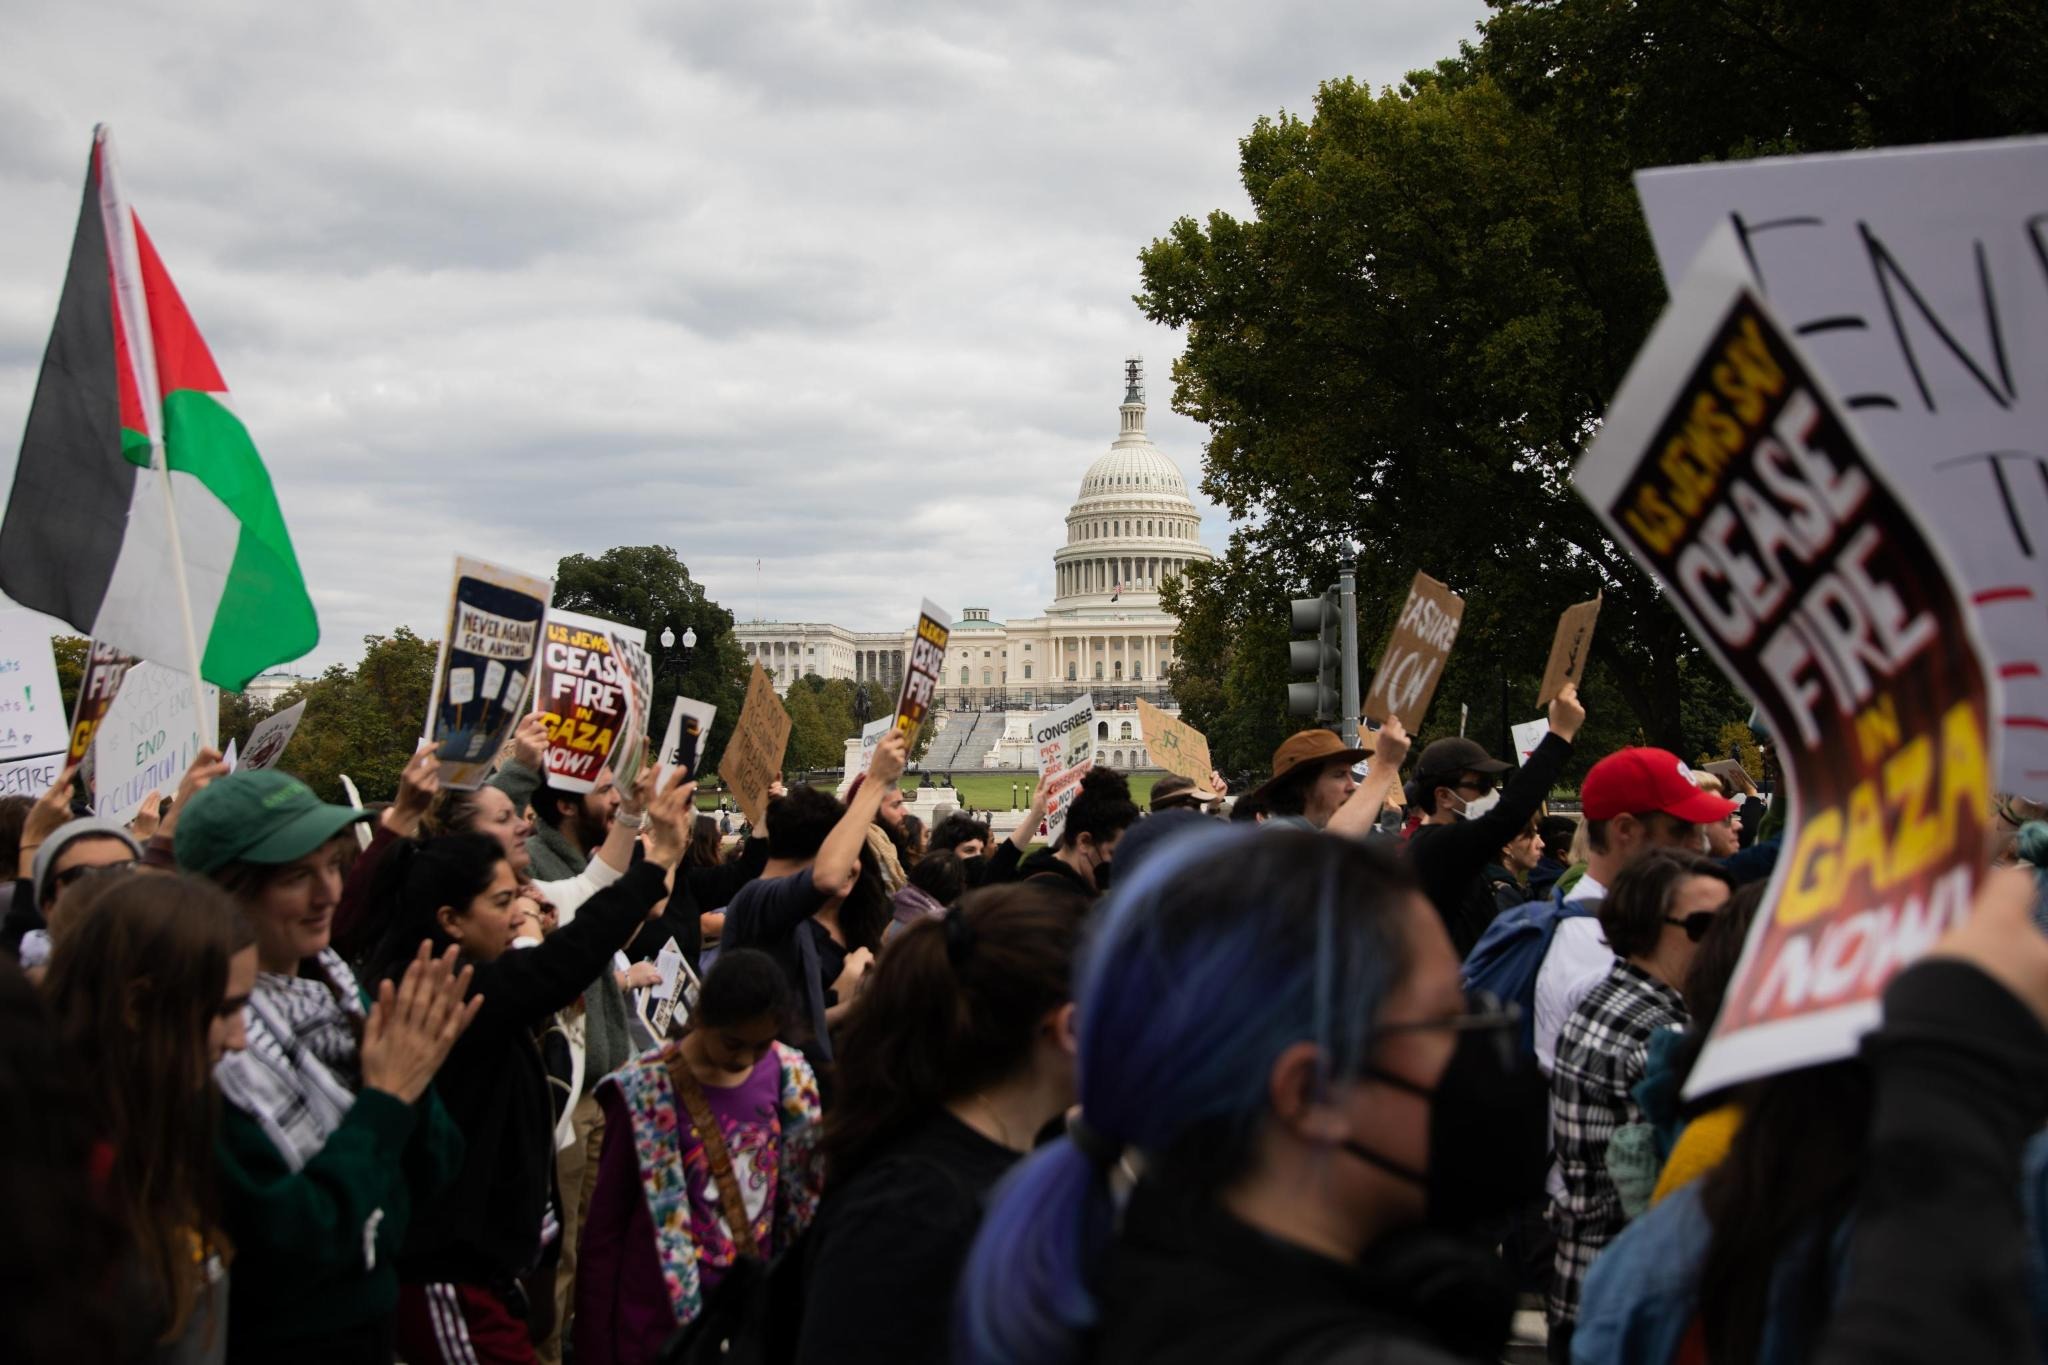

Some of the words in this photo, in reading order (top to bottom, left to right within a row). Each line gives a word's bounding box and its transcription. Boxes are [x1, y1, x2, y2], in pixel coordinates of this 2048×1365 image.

[1729, 210, 2048, 412] EN
[1676, 387, 1869, 647] CEASE
[463, 612, 500, 638] NEVER
[501, 617, 532, 646] AGAIN
[464, 633, 486, 652] FOR
[489, 639, 527, 658] ANYONE
[570, 630, 611, 654] JEWS
[1757, 524, 1940, 750] FIRE
[551, 672, 623, 716] FIRE
[575, 706, 594, 721] IN
[1036, 707, 1093, 744] CONGRESS
[136, 729, 166, 767] END
[542, 713, 612, 756] GAZA
[1040, 742, 1061, 758] PICK
[1058, 786, 1076, 806] NOT
[1776, 701, 1988, 927] GAZA
[1049, 804, 1069, 830] GENO
